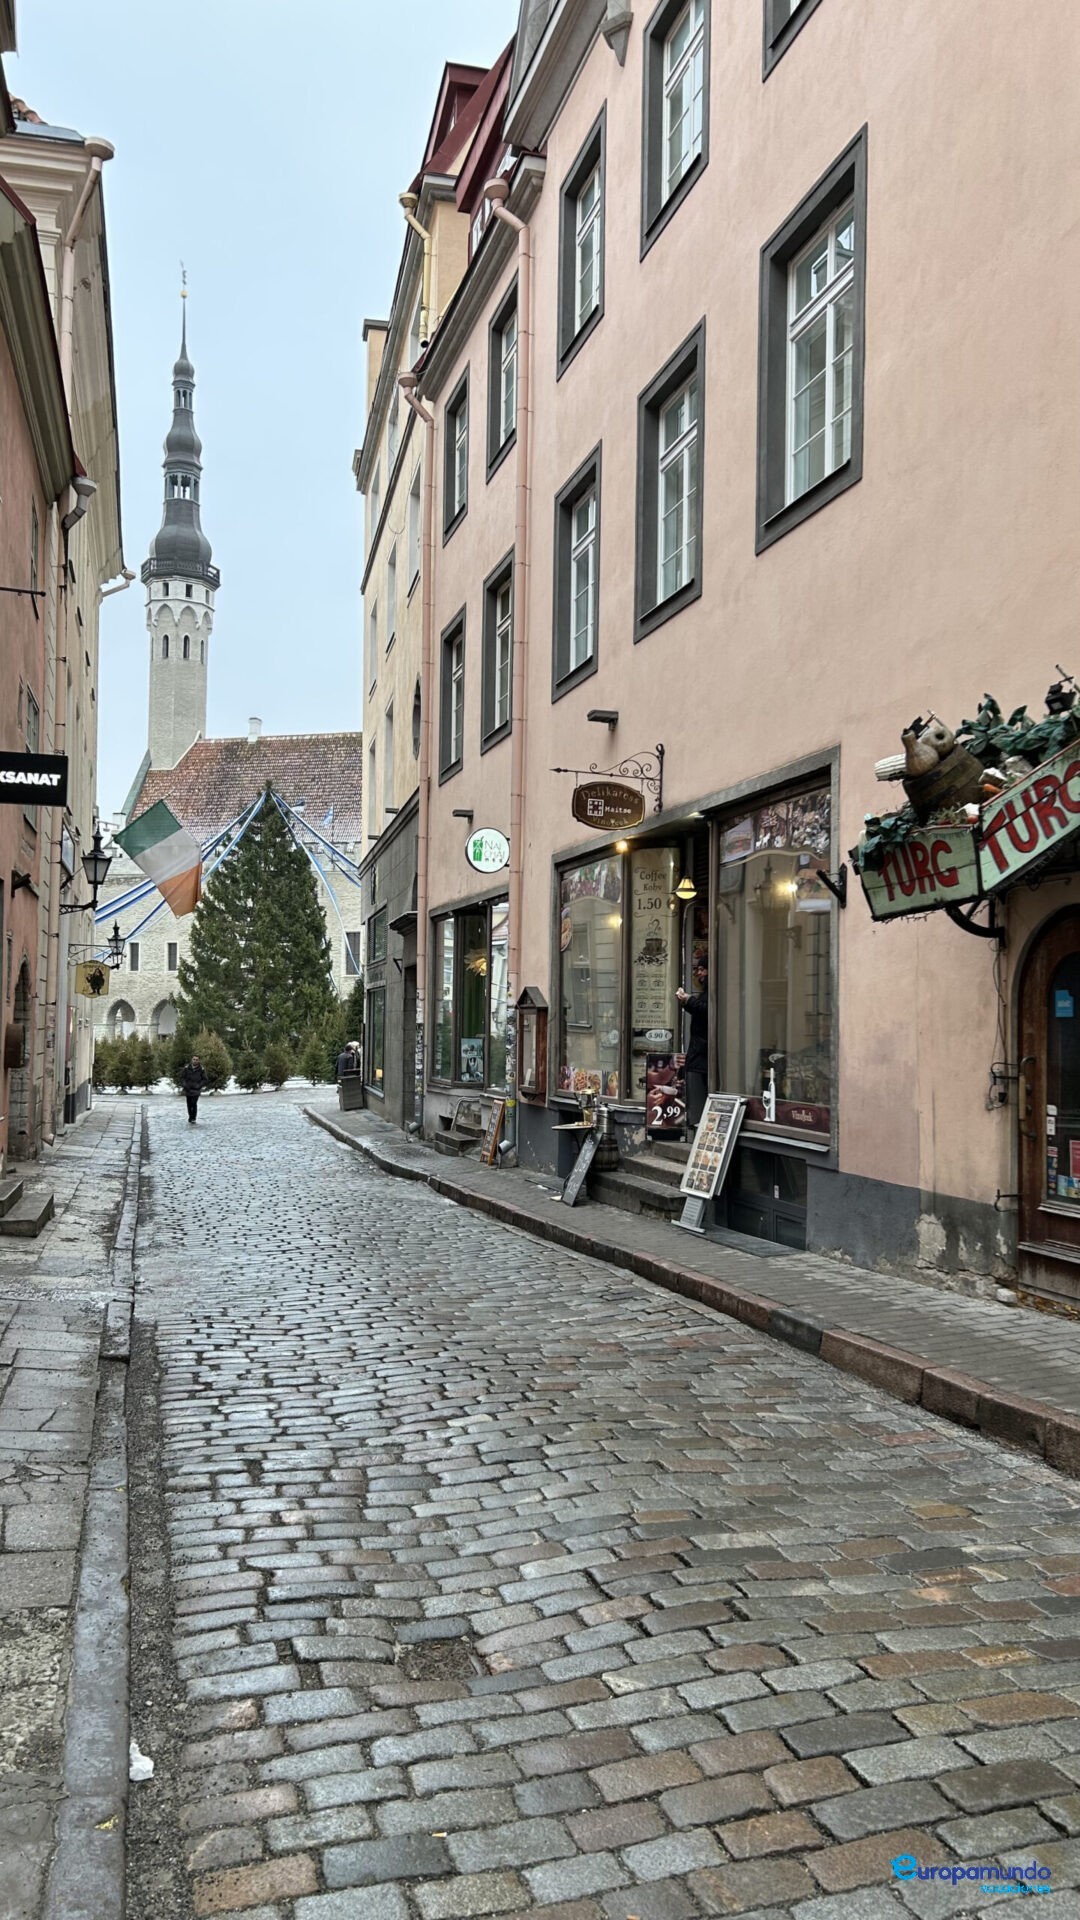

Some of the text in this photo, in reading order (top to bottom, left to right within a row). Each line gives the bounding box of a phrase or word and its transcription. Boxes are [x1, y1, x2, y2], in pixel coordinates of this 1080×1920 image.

[639, 870, 667, 881] Coffee
[878, 839, 960, 902] TURG
[637, 898, 662, 910] 1.50
[651, 1105, 681, 1125] 2,99
